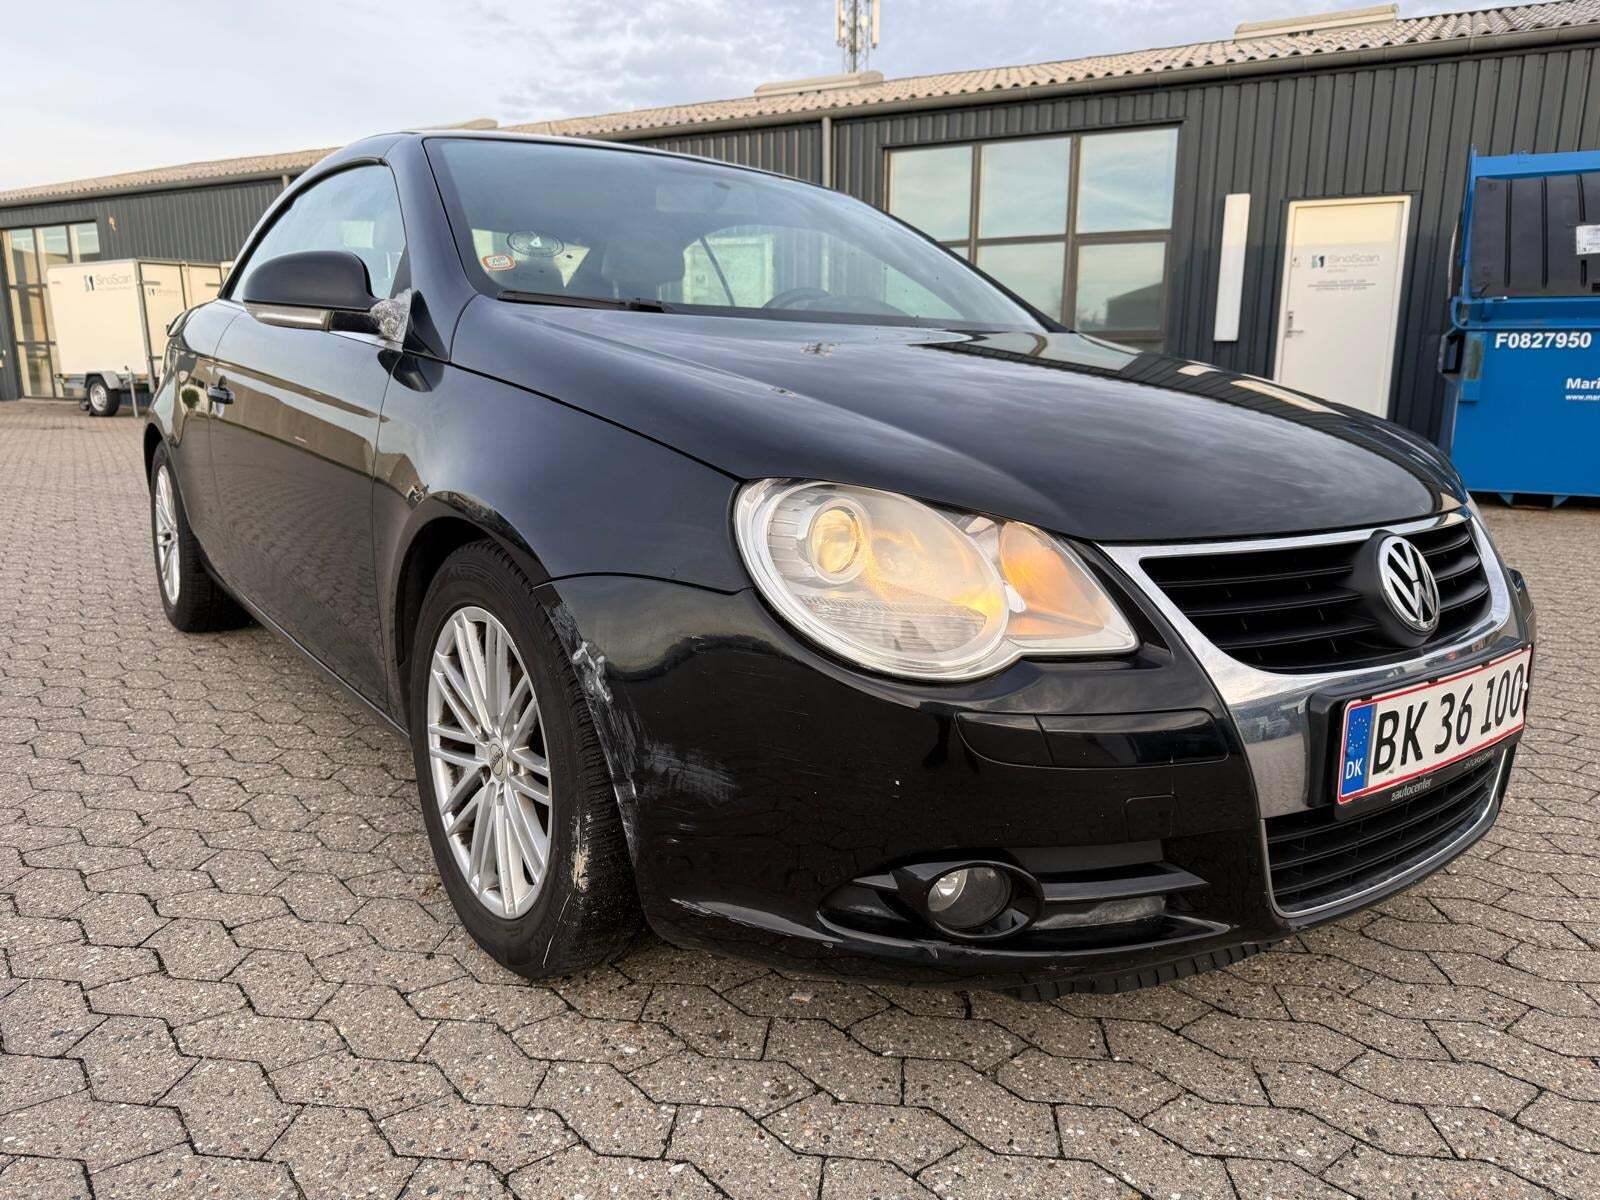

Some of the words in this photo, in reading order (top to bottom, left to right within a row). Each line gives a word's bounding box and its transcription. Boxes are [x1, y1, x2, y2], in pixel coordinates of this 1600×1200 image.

[1494, 332, 1592, 349] F0827950
[1372, 701, 1429, 775] BK
[1434, 684, 1474, 754] 36
[1480, 662, 1526, 735] 100
[1345, 760, 1363, 780] DK
